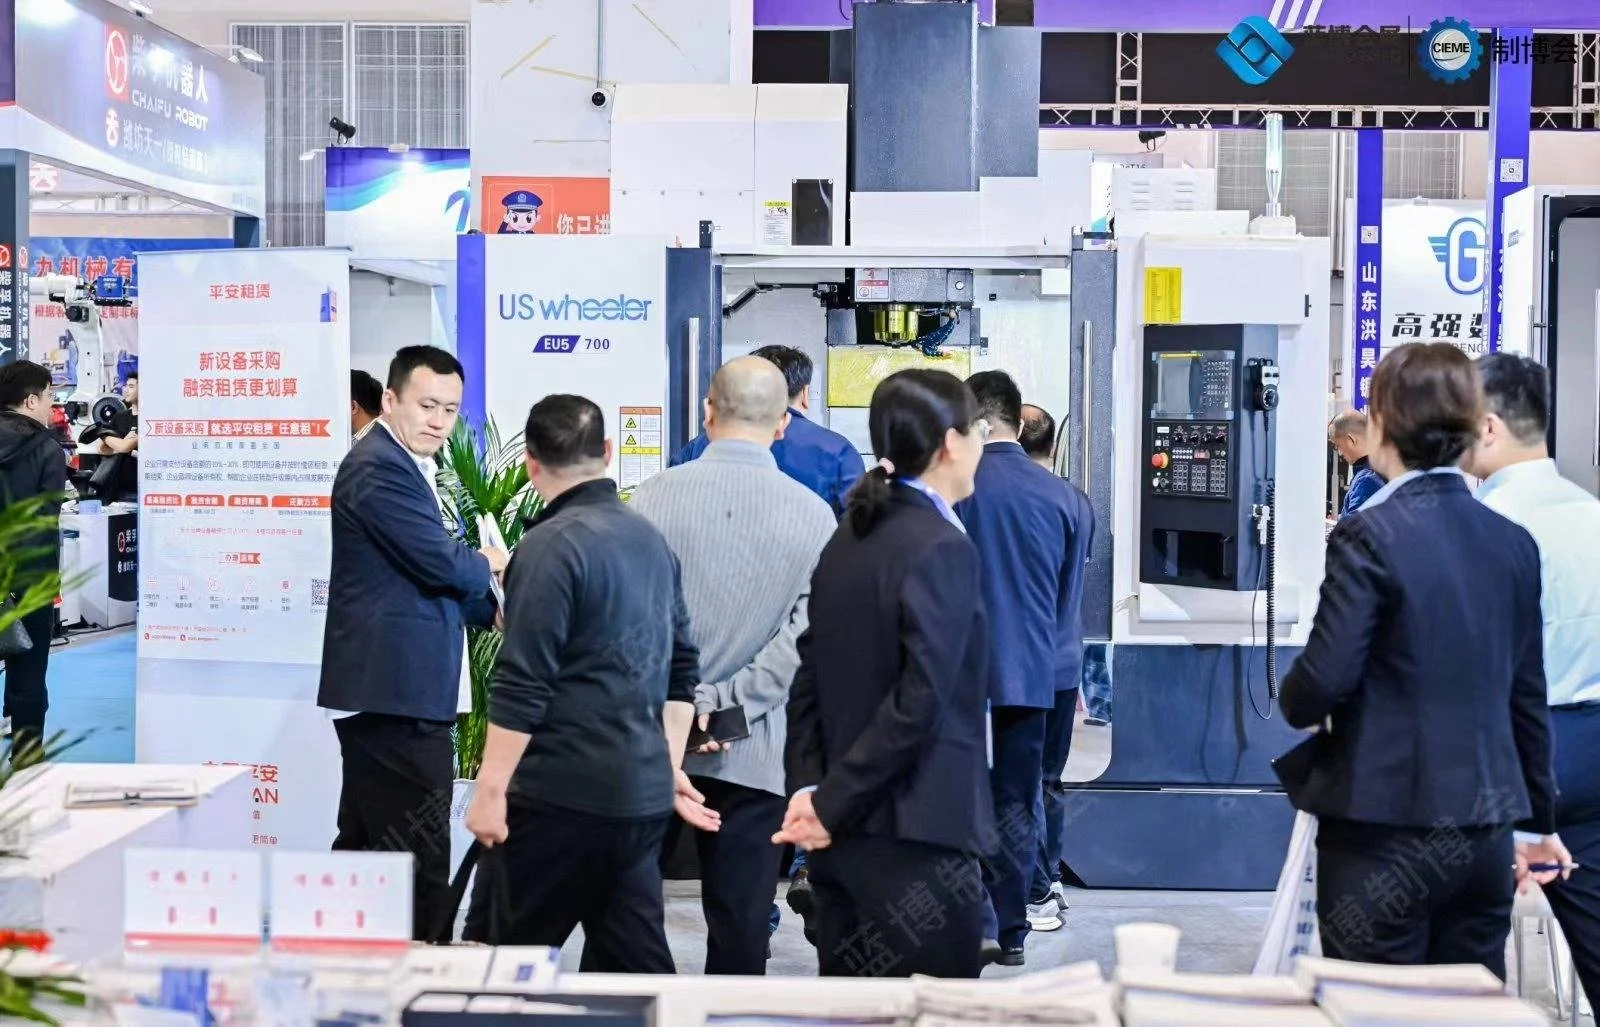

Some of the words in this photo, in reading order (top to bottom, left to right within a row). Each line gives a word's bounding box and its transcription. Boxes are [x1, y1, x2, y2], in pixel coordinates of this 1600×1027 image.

[209, 283, 271, 300] 平安租赁
[499, 293, 534, 321] US
[539, 293, 652, 321] wheeler
[544, 337, 570, 350] EU5
[584, 338, 610, 350] 700
[199, 351, 281, 371] 新设备采购
[183, 377, 298, 398] 融资租赁更划算
[154, 422, 205, 434] 新设备采购
